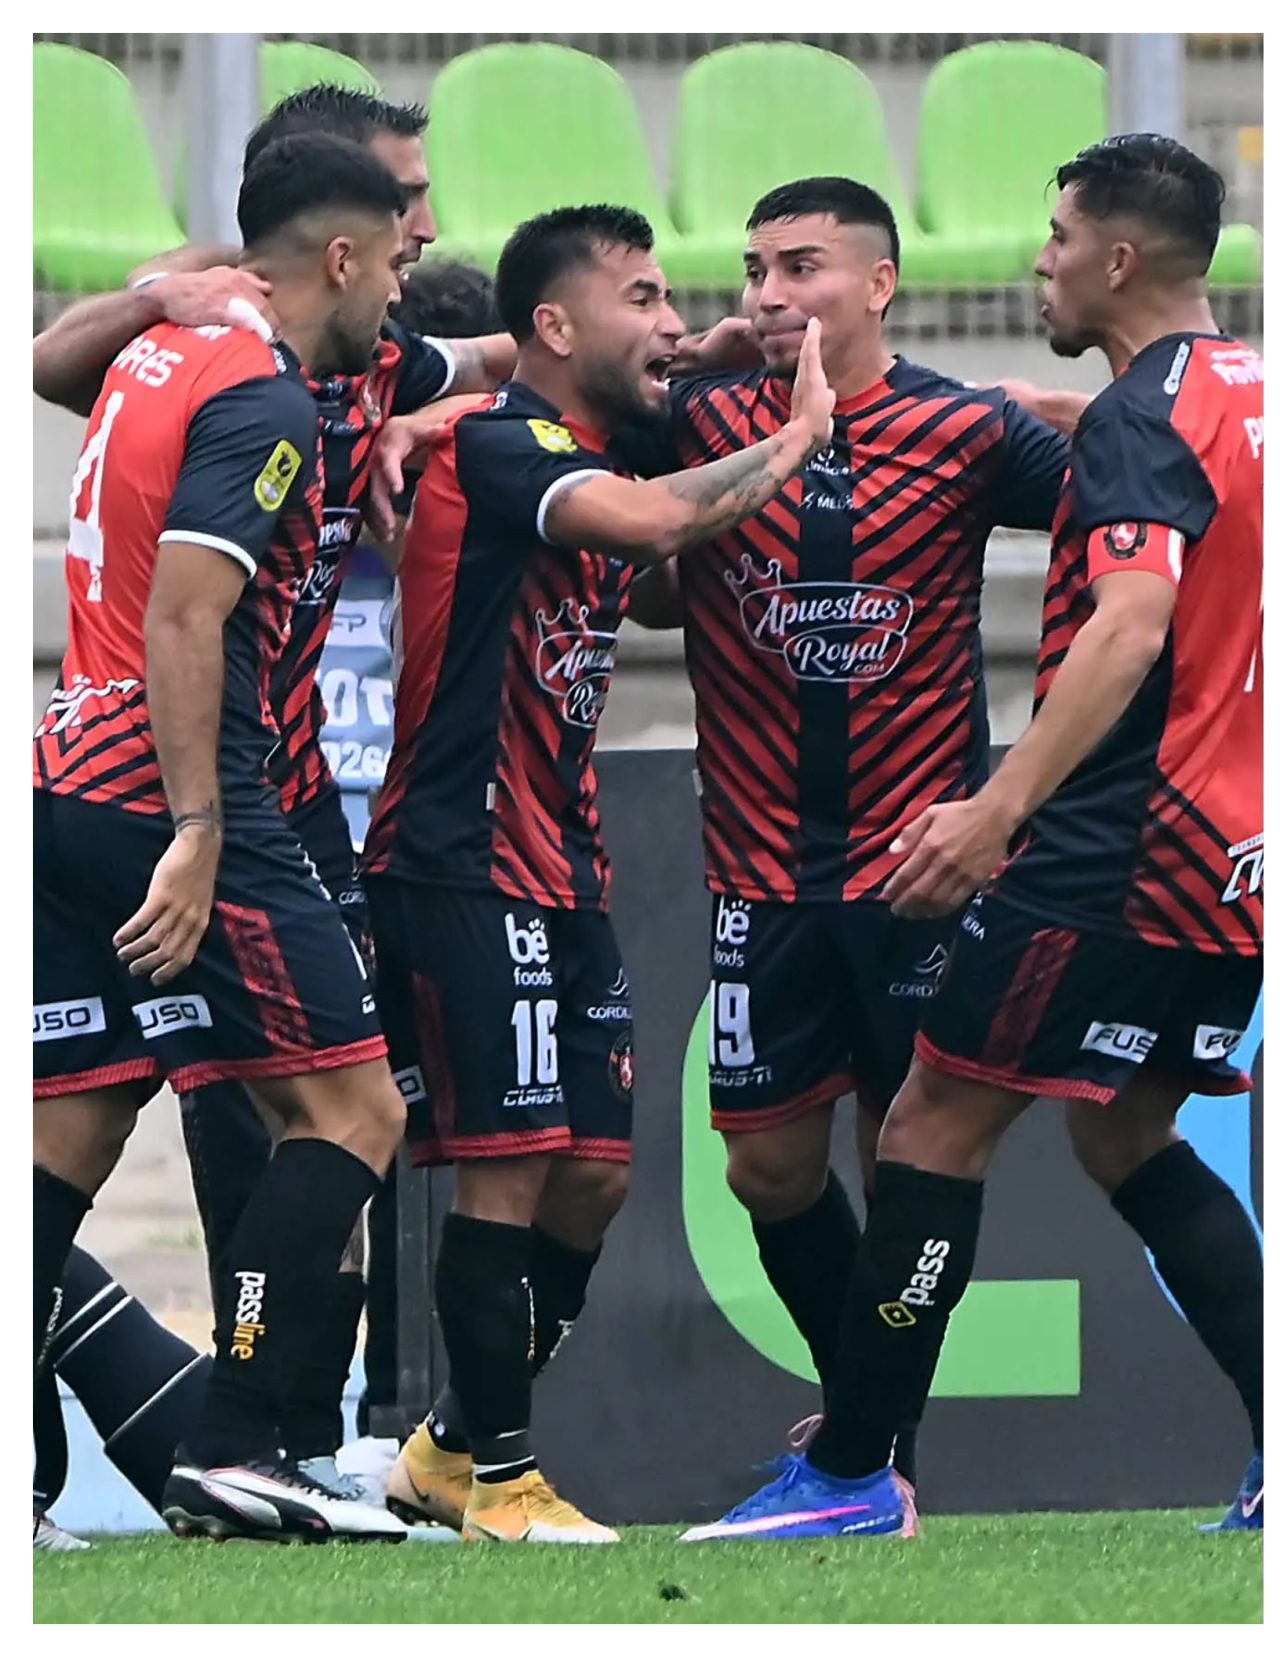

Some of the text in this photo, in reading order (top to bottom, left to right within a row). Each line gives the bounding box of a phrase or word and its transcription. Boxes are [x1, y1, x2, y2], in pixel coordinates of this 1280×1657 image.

[753, 590, 900, 638] Apuestas
[794, 632, 891, 675] Royal
[504, 912, 550, 964] be
[513, 966, 553, 987] foods
[511, 999, 559, 1086] 16
[230, 1271, 267, 1360] passline
